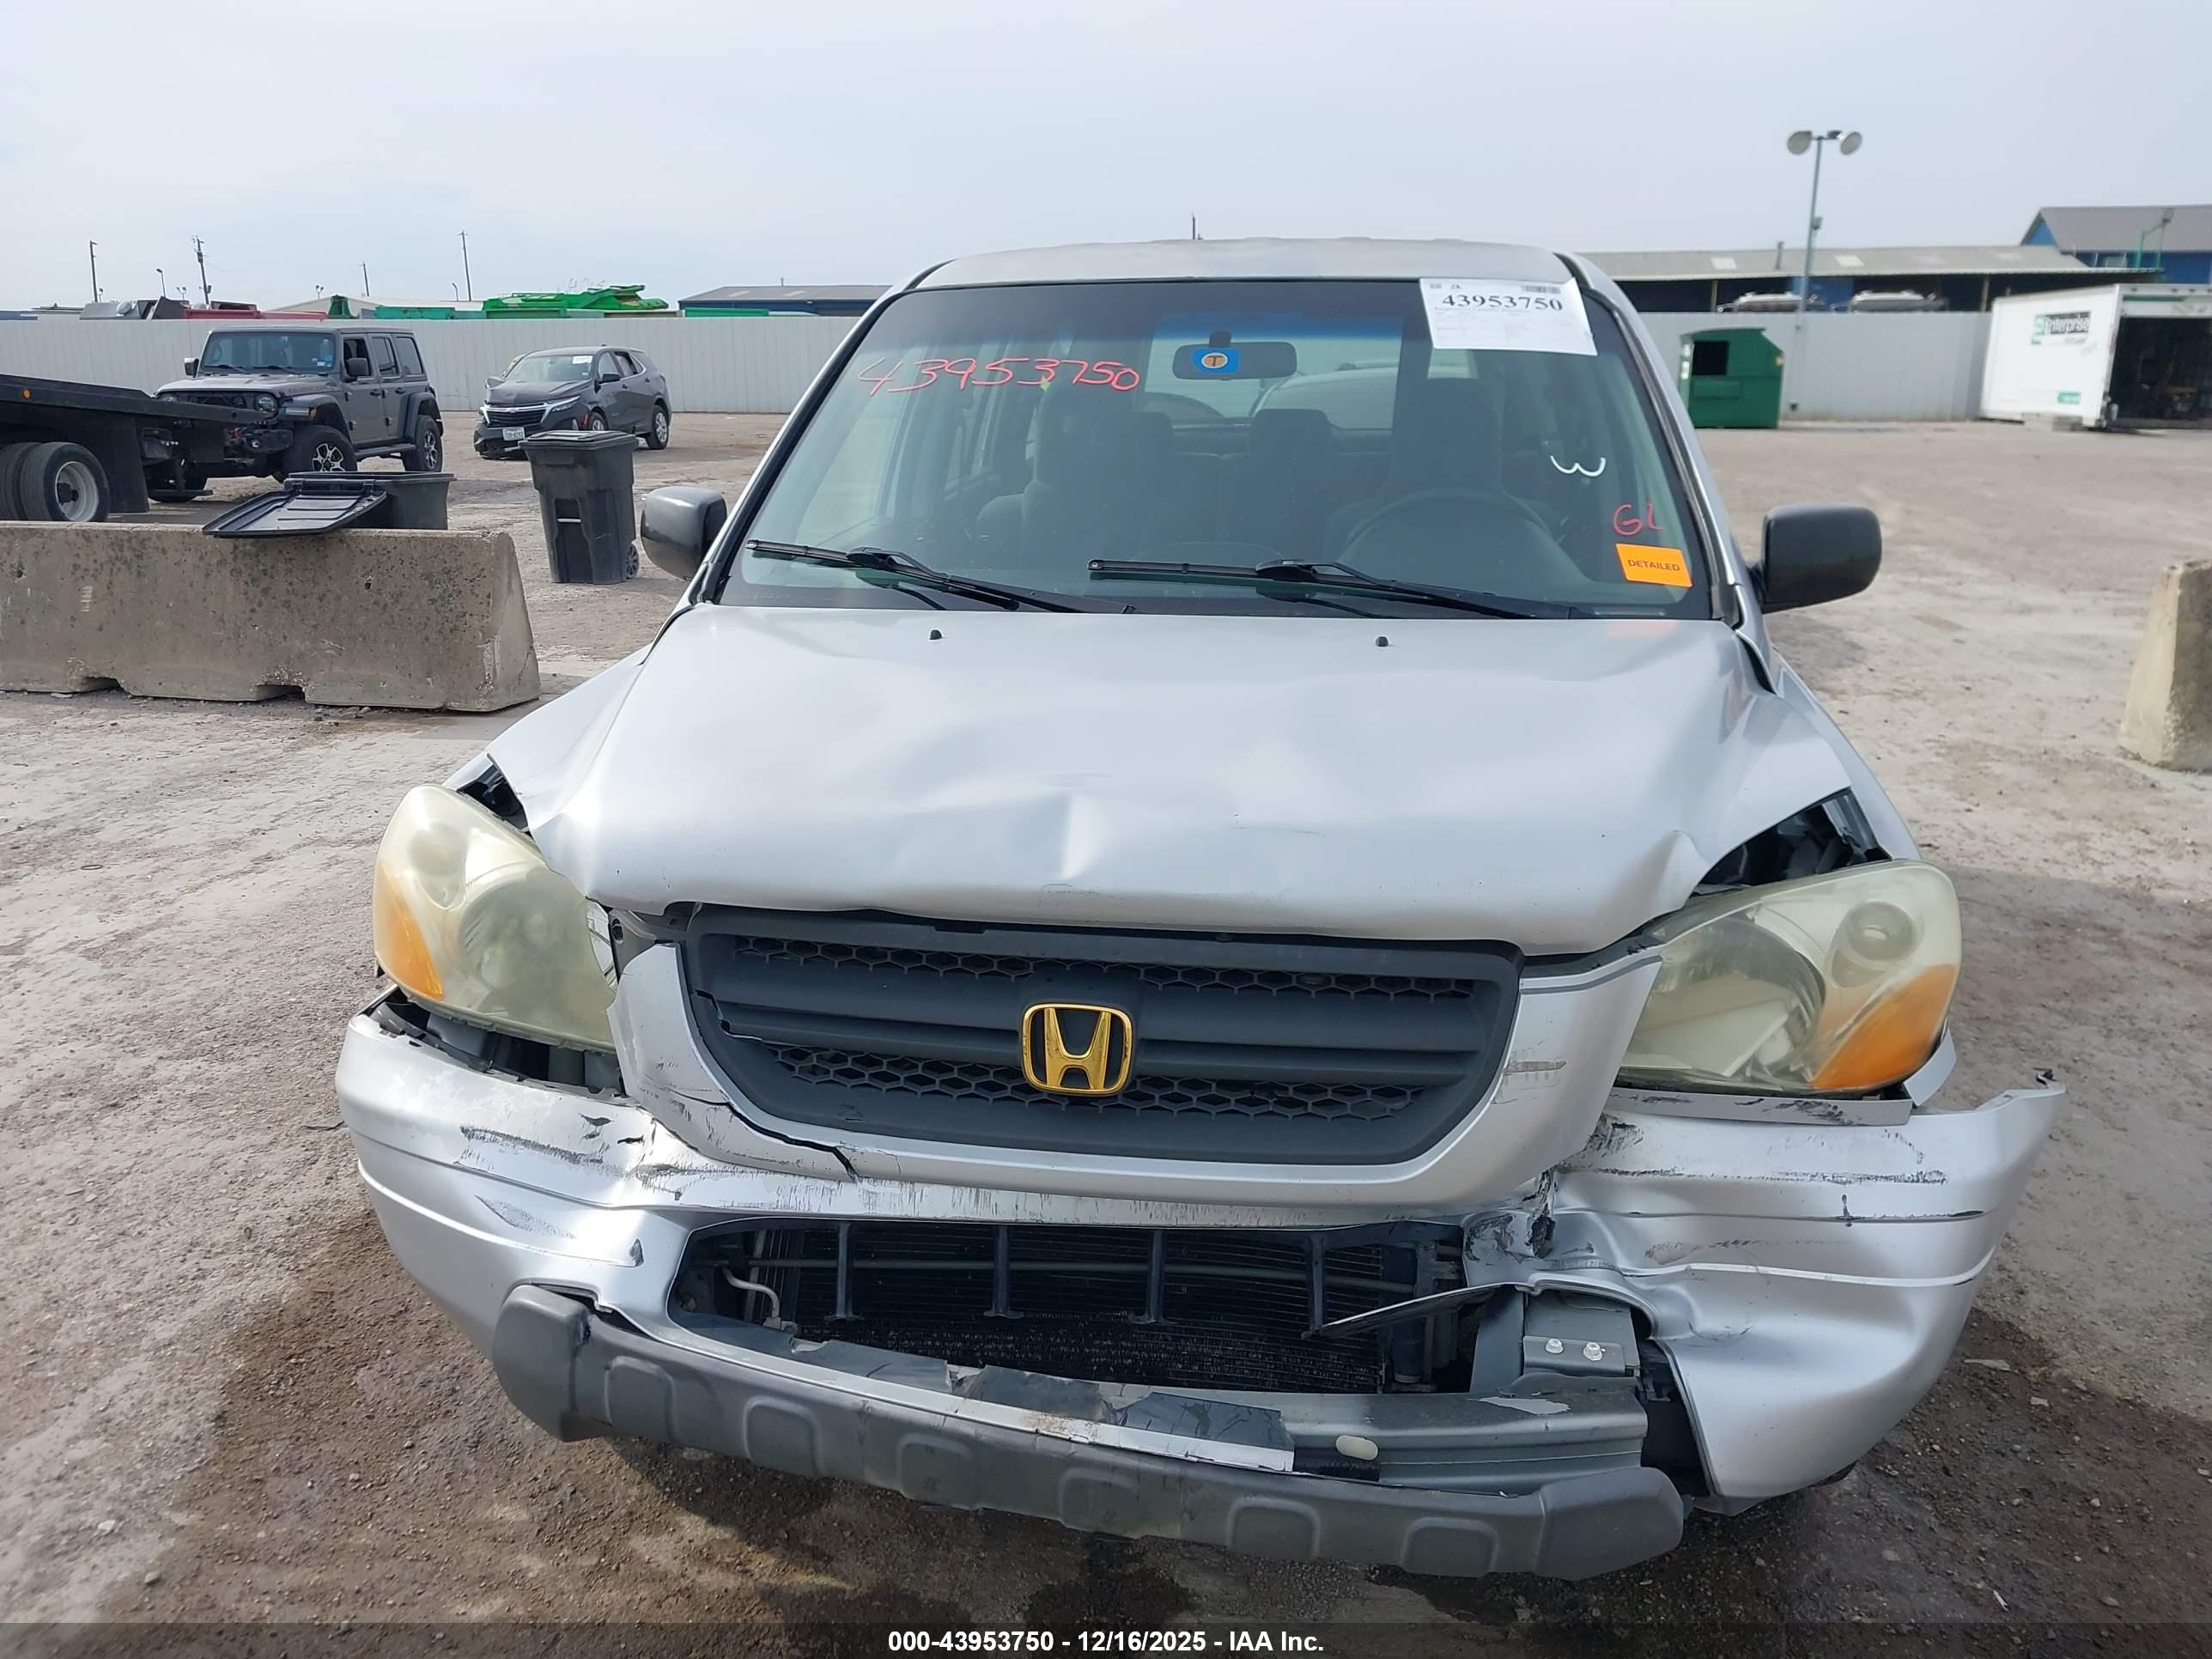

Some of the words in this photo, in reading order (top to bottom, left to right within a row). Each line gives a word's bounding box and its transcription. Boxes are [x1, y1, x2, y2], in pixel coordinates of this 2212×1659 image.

[1442, 294, 1564, 312] 43953750
[859, 357, 1141, 398] 43953750
[1627, 559, 1680, 571] DETAILED
